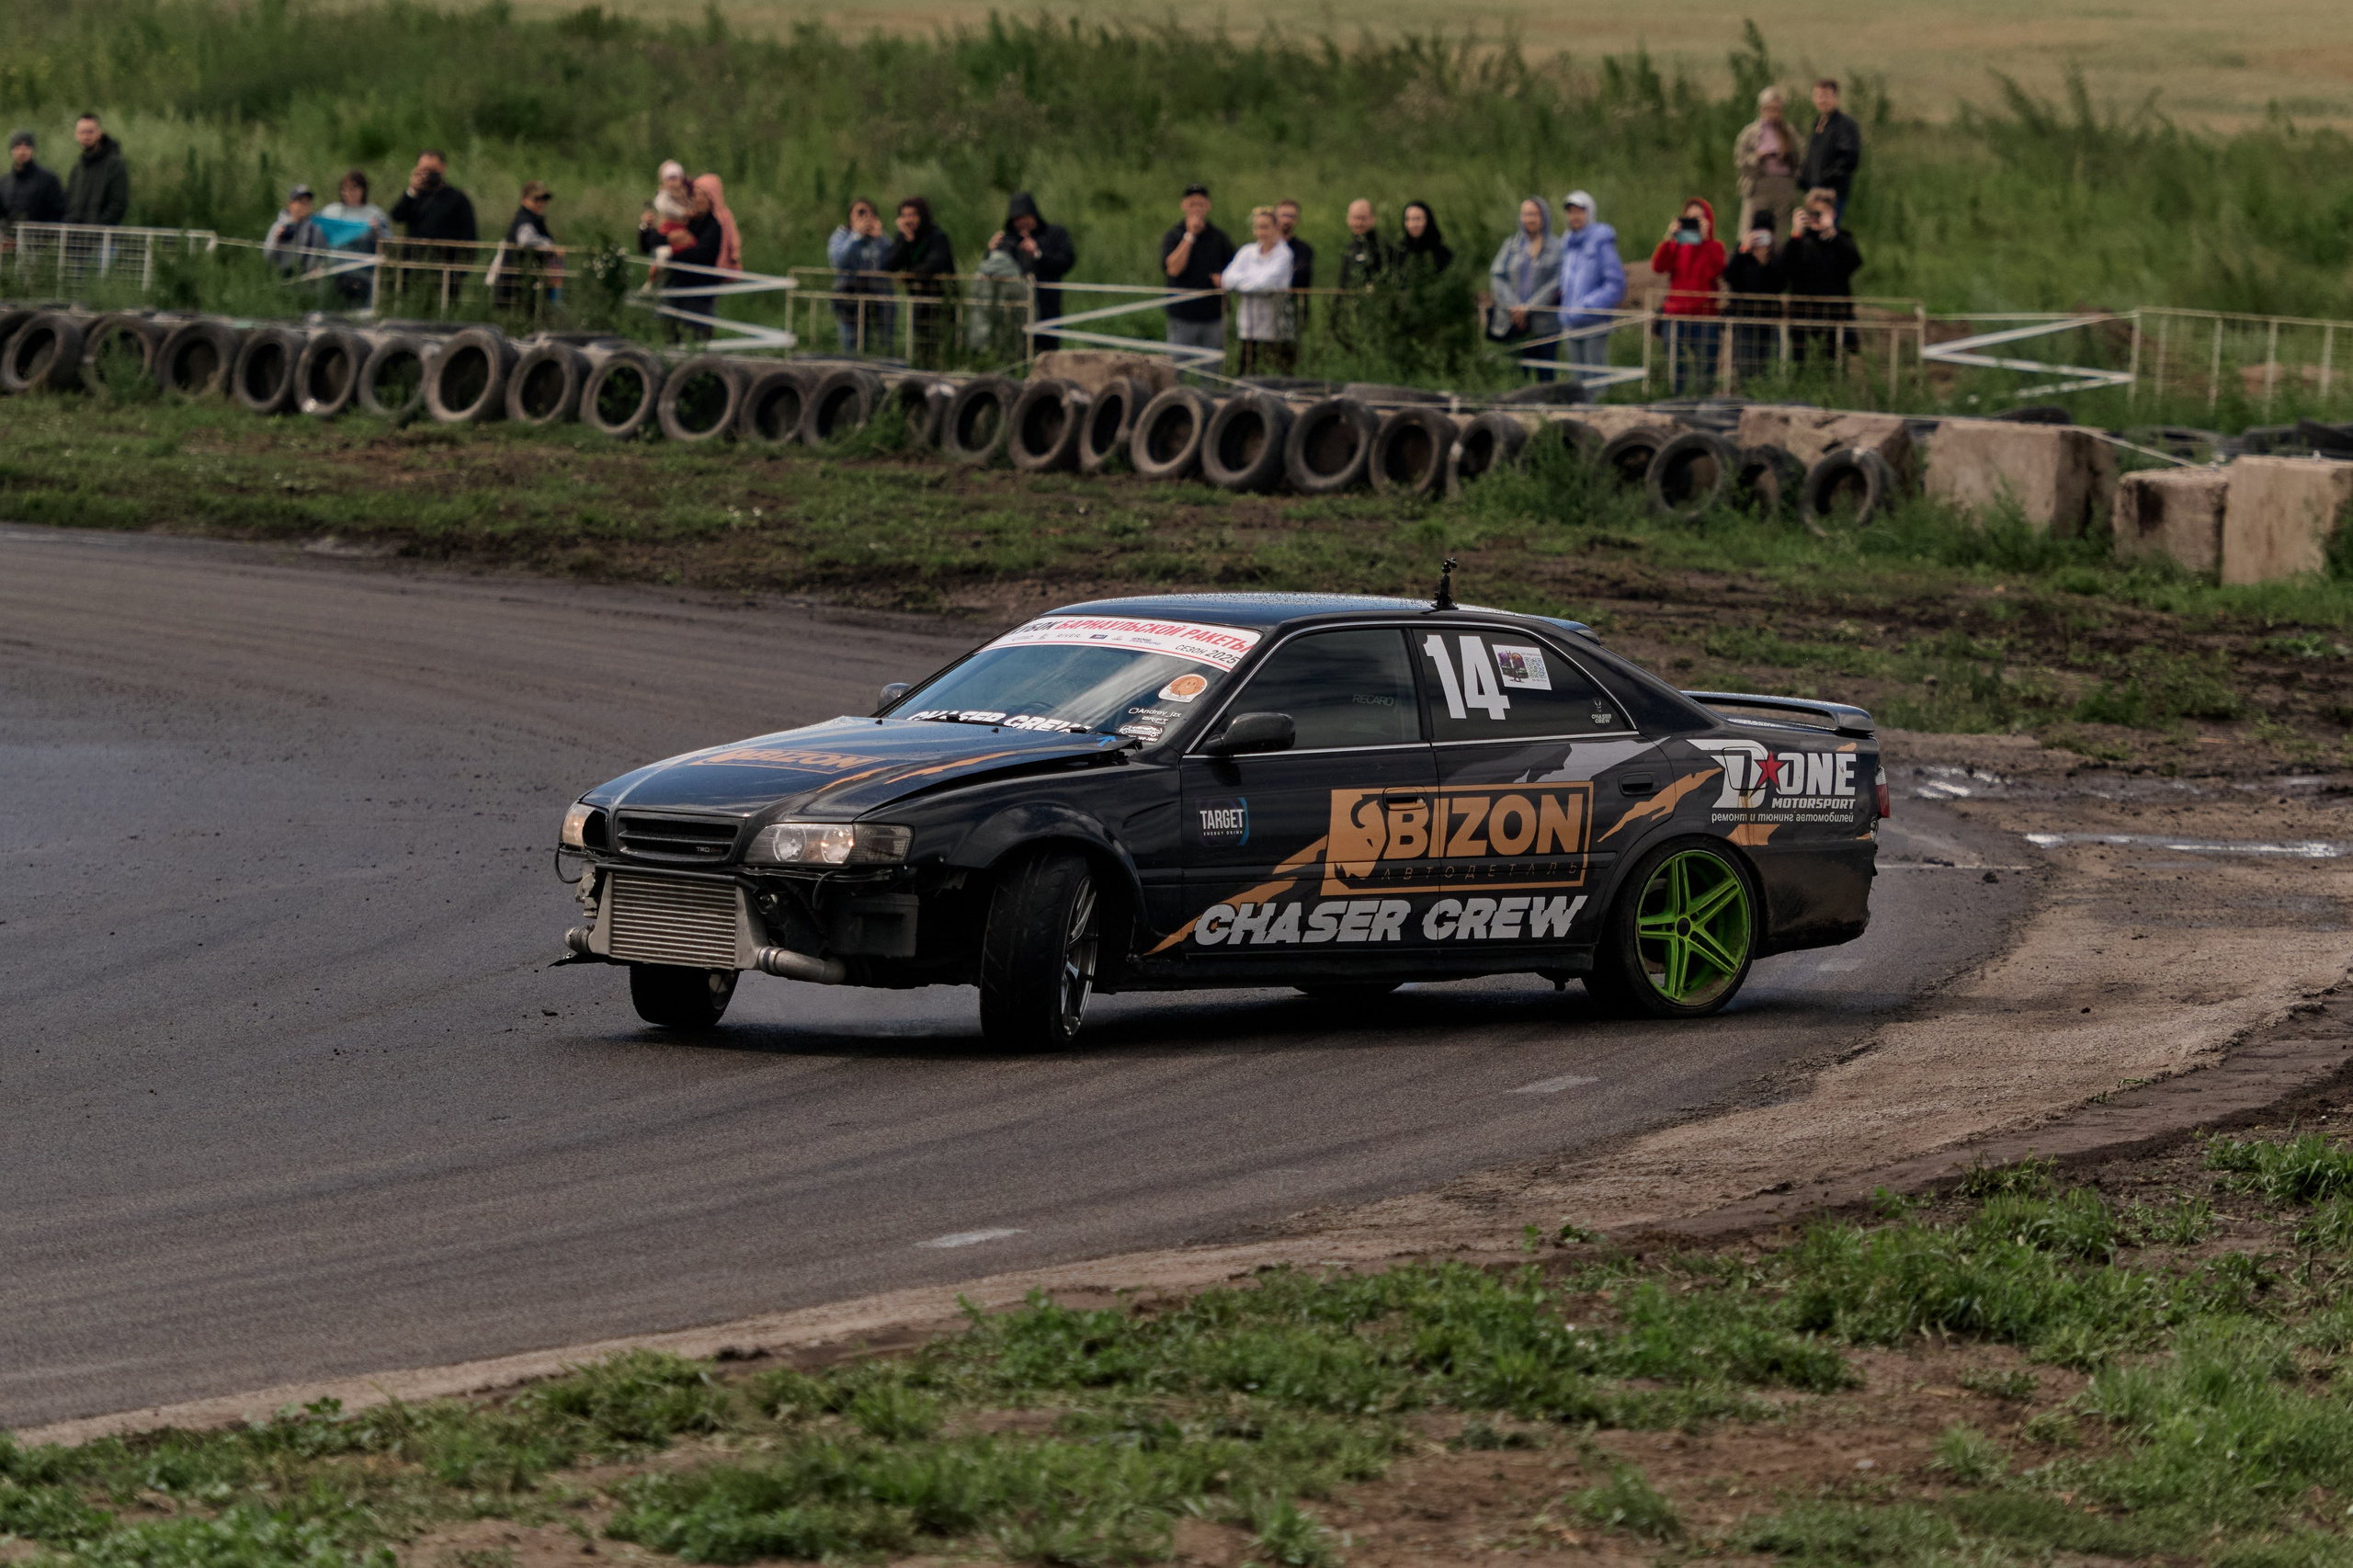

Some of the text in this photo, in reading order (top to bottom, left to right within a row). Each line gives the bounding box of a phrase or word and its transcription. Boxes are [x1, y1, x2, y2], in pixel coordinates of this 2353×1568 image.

[1054, 620, 1186, 636] БАРНАУЛЬСКОЙ
[1179, 629, 1256, 653] РАКЕТЫ
[1175, 644, 1241, 665] СЕЗОН 2025
[1423, 634, 1510, 720] 14
[1353, 694, 1393, 706] RECARO
[1771, 798, 1856, 809] MOTORSPORT
[1199, 810, 1244, 829] TARGET
[1382, 793, 1584, 859] BIZON
[1711, 812, 1854, 823] ремонт и тюнинг автомобилей
[1195, 895, 1588, 945] CHASER CREW
